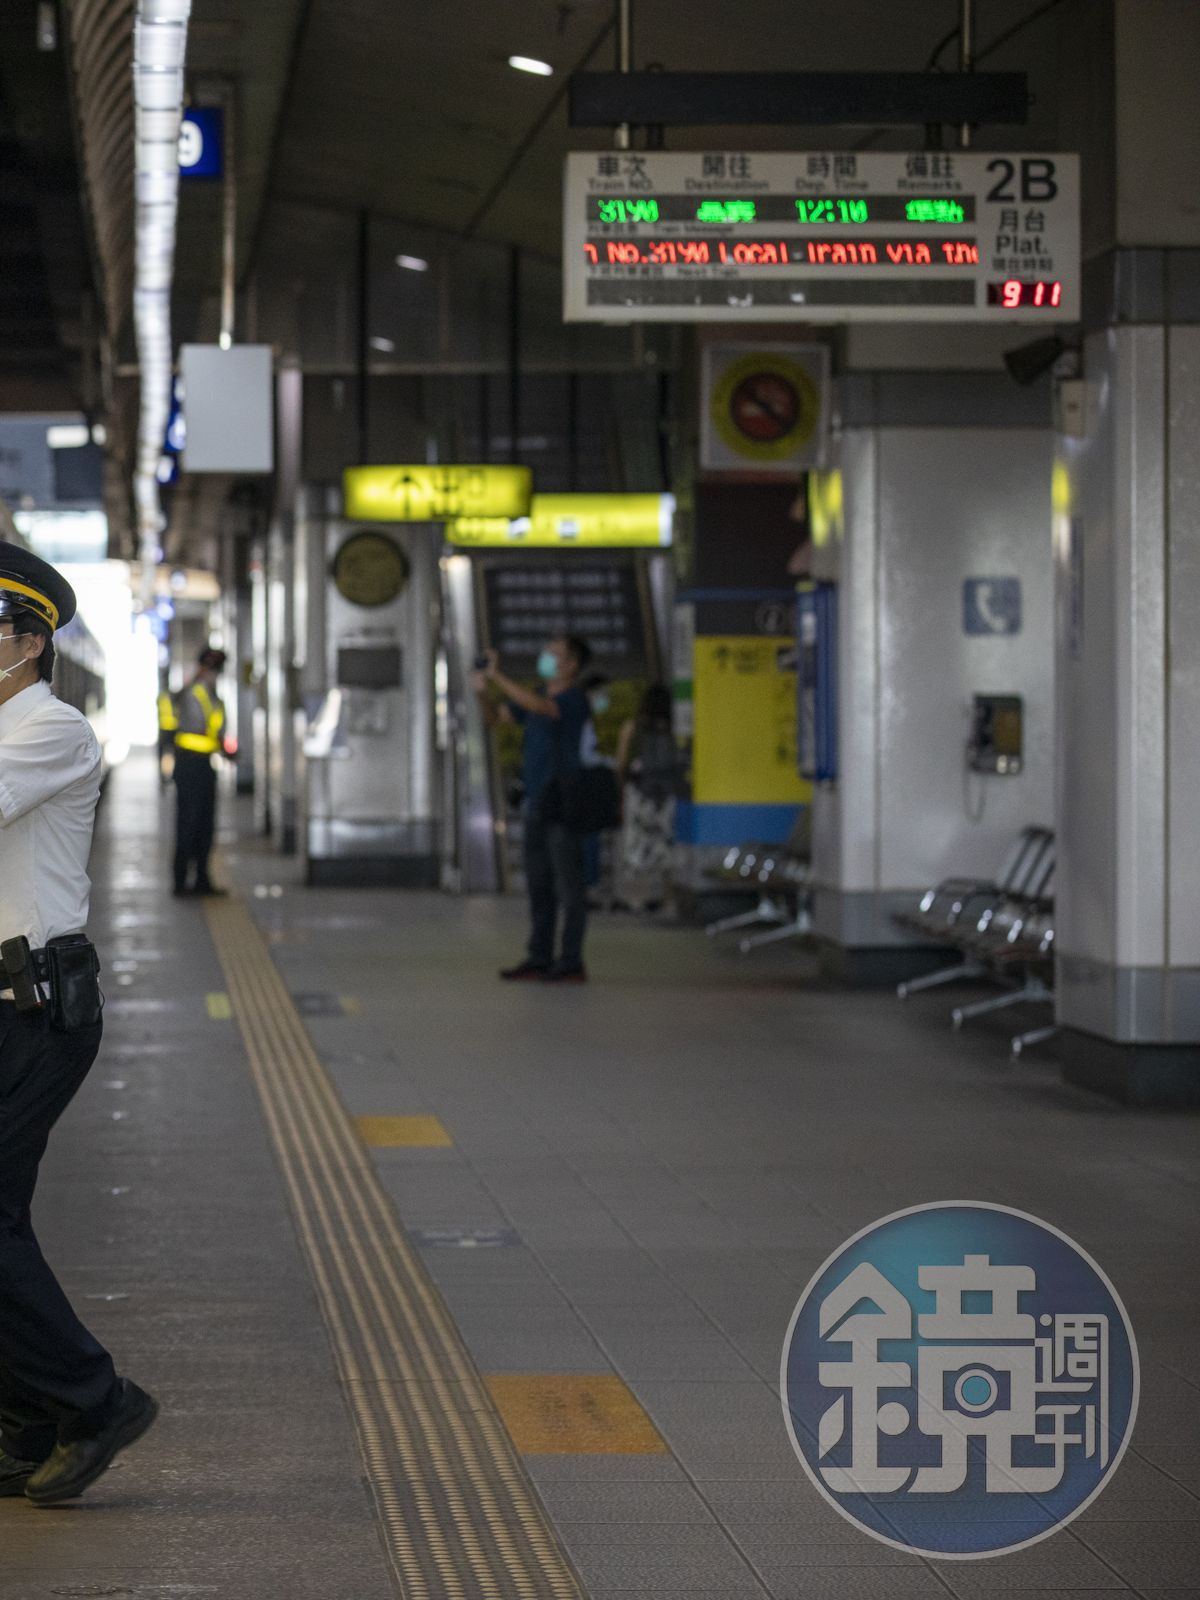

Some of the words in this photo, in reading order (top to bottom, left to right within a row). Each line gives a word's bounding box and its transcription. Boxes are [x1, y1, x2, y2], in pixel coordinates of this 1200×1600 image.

[597, 155, 647, 178] 車次
[806, 154, 857, 178] 時間
[906, 154, 954, 178] 備註
[986, 159, 1058, 203] 2B
[795, 199, 868, 223] 12:10
[1000, 208, 1044, 232] 月台
[886, 242, 931, 265] via
[996, 235, 1048, 254] Plat.
